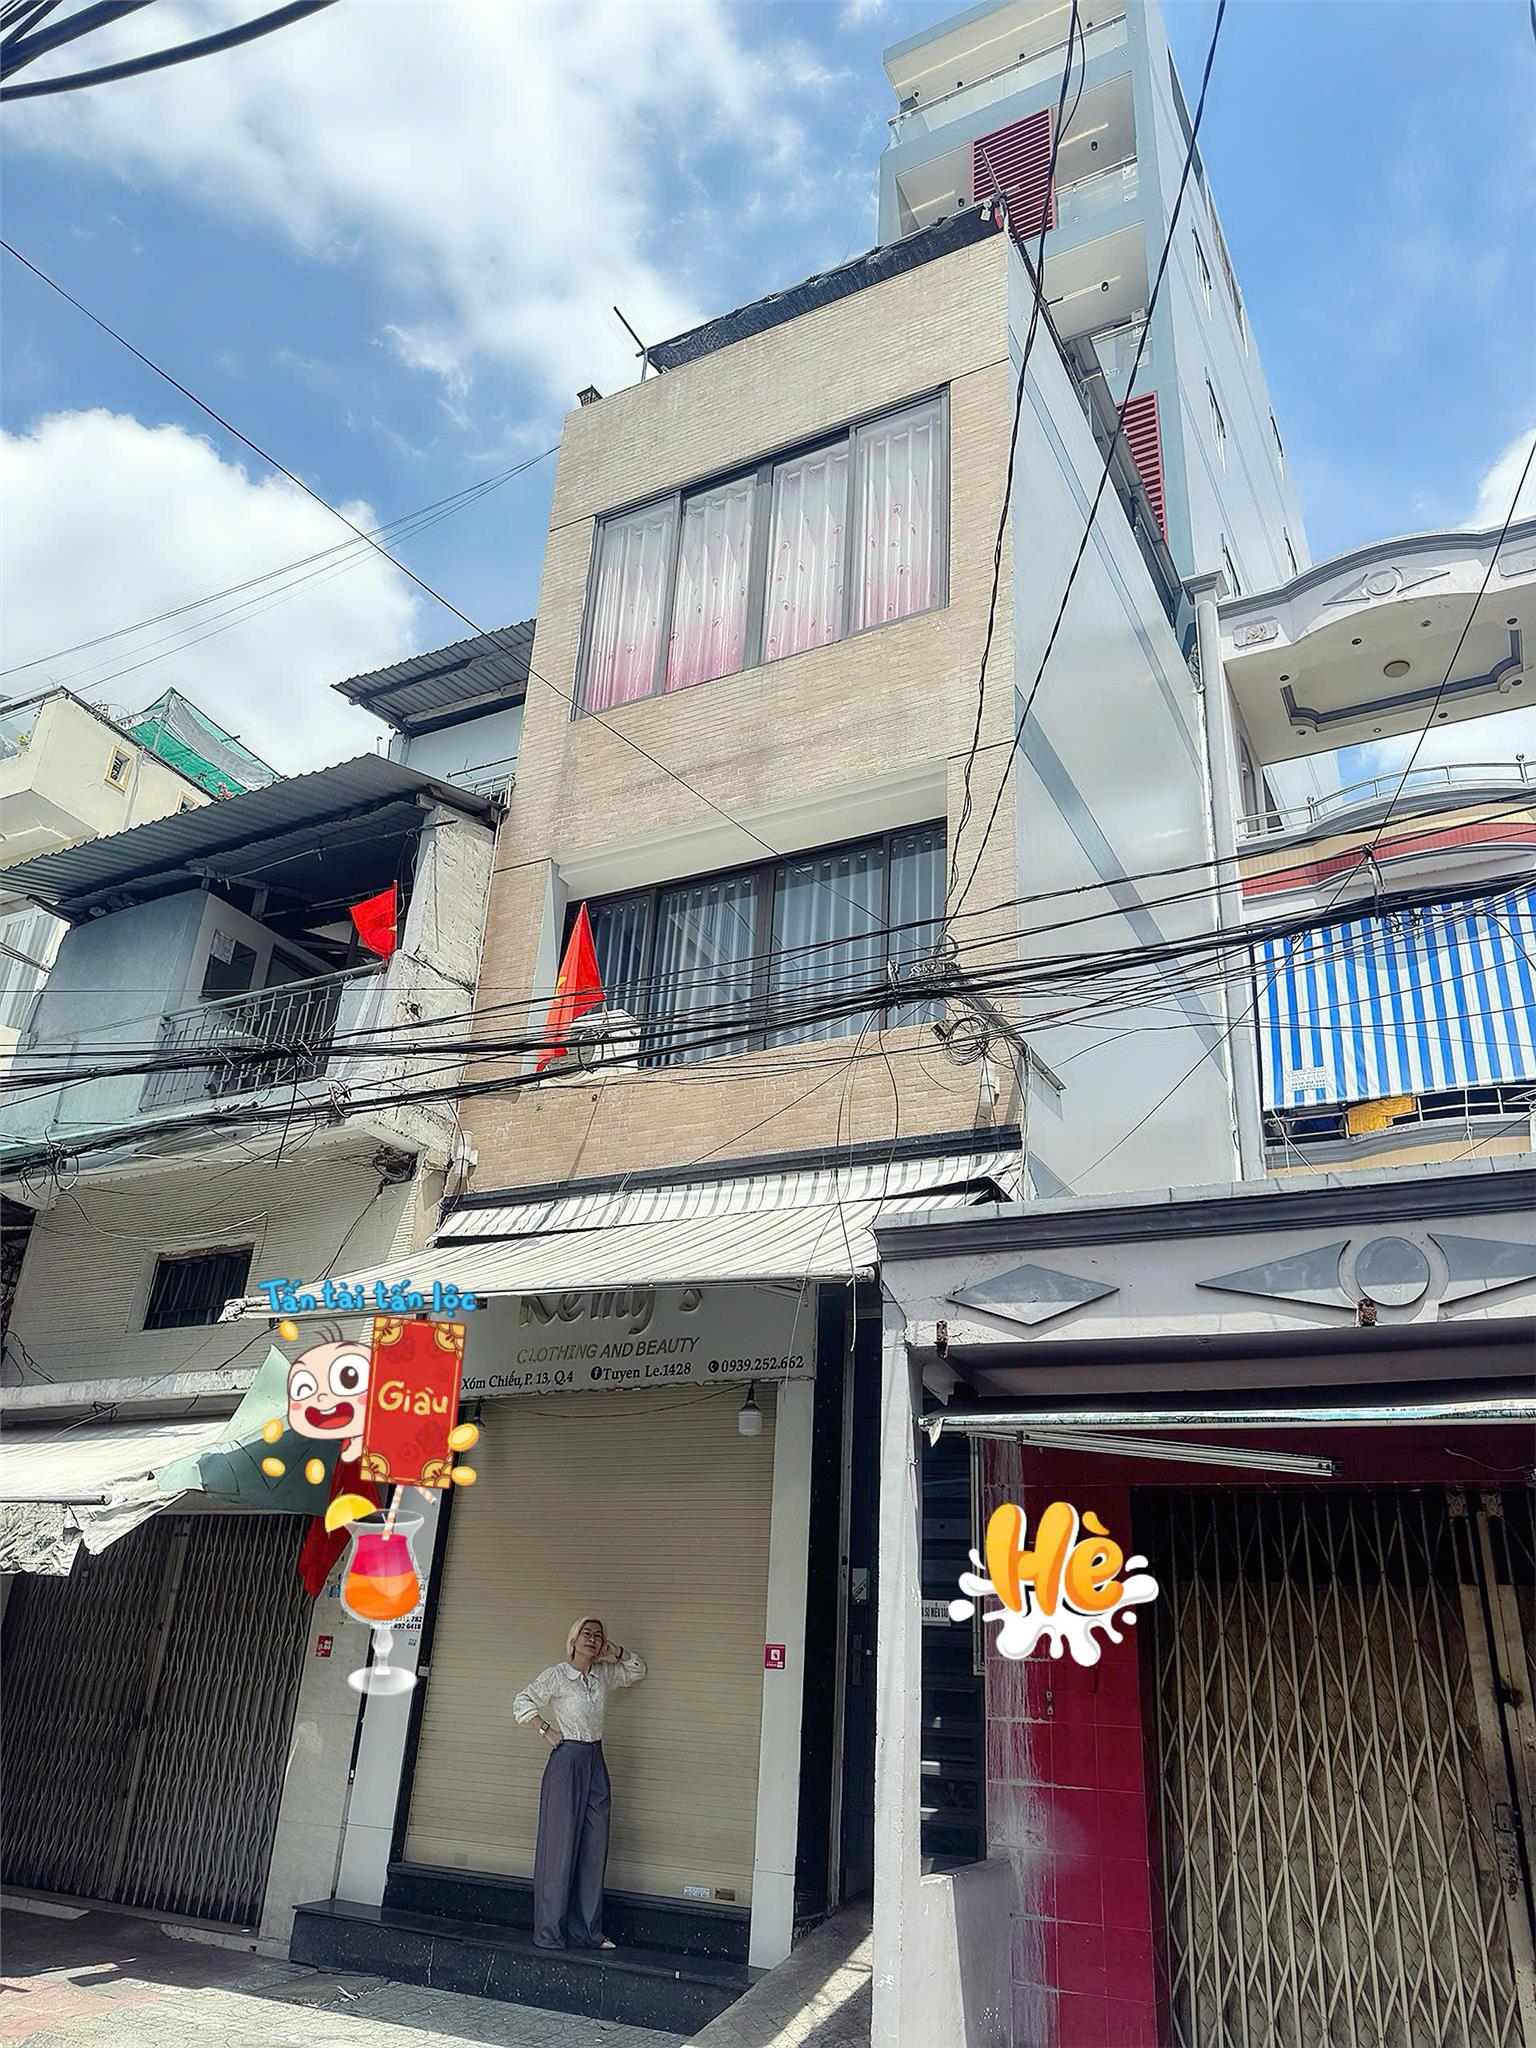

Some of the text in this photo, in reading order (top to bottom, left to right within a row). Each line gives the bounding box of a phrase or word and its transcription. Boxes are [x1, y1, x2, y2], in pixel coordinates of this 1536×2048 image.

[517, 1337, 701, 1364] CLOTHING AND BEAUTY
[602, 1362, 692, 1383] Tuyen Le.1428
[720, 1355, 805, 1374] 0939.252.662
[461, 1376, 486, 1391] Xóm
